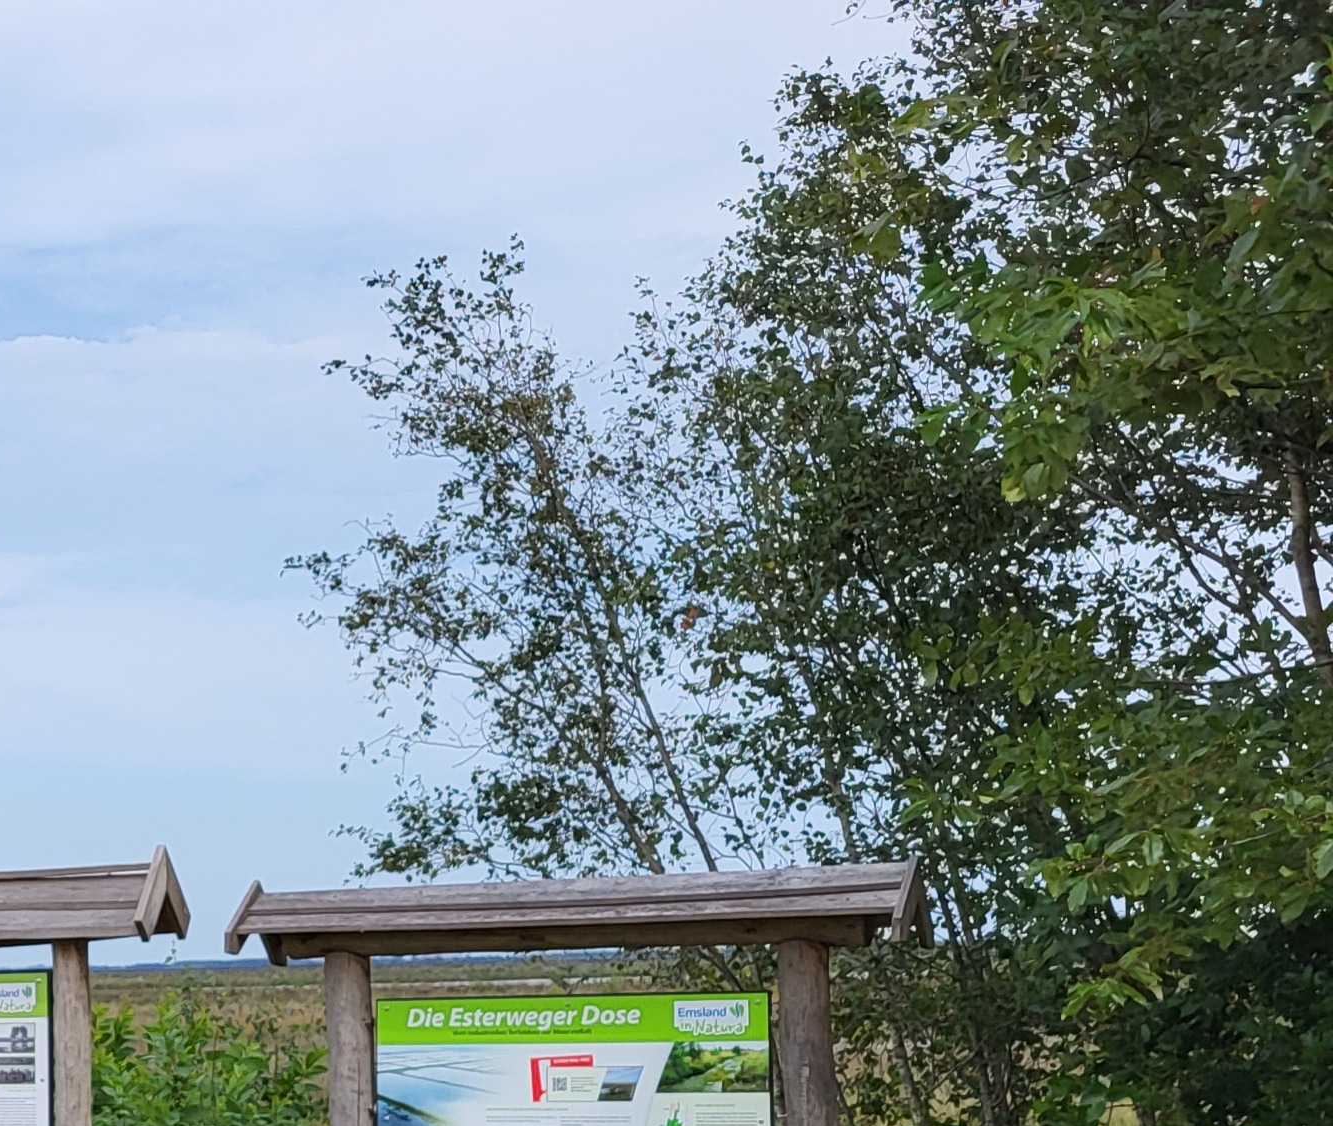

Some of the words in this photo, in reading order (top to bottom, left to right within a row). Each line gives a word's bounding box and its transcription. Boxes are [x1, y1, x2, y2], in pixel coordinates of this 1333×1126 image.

[406, 1007, 445, 1028] Die
[448, 1006, 578, 1031] Esterweger
[580, 1005, 641, 1025] Dose
[677, 1006, 727, 1018] Emsland
[680, 1019, 692, 1030] in
[694, 1019, 744, 1035] Natura
